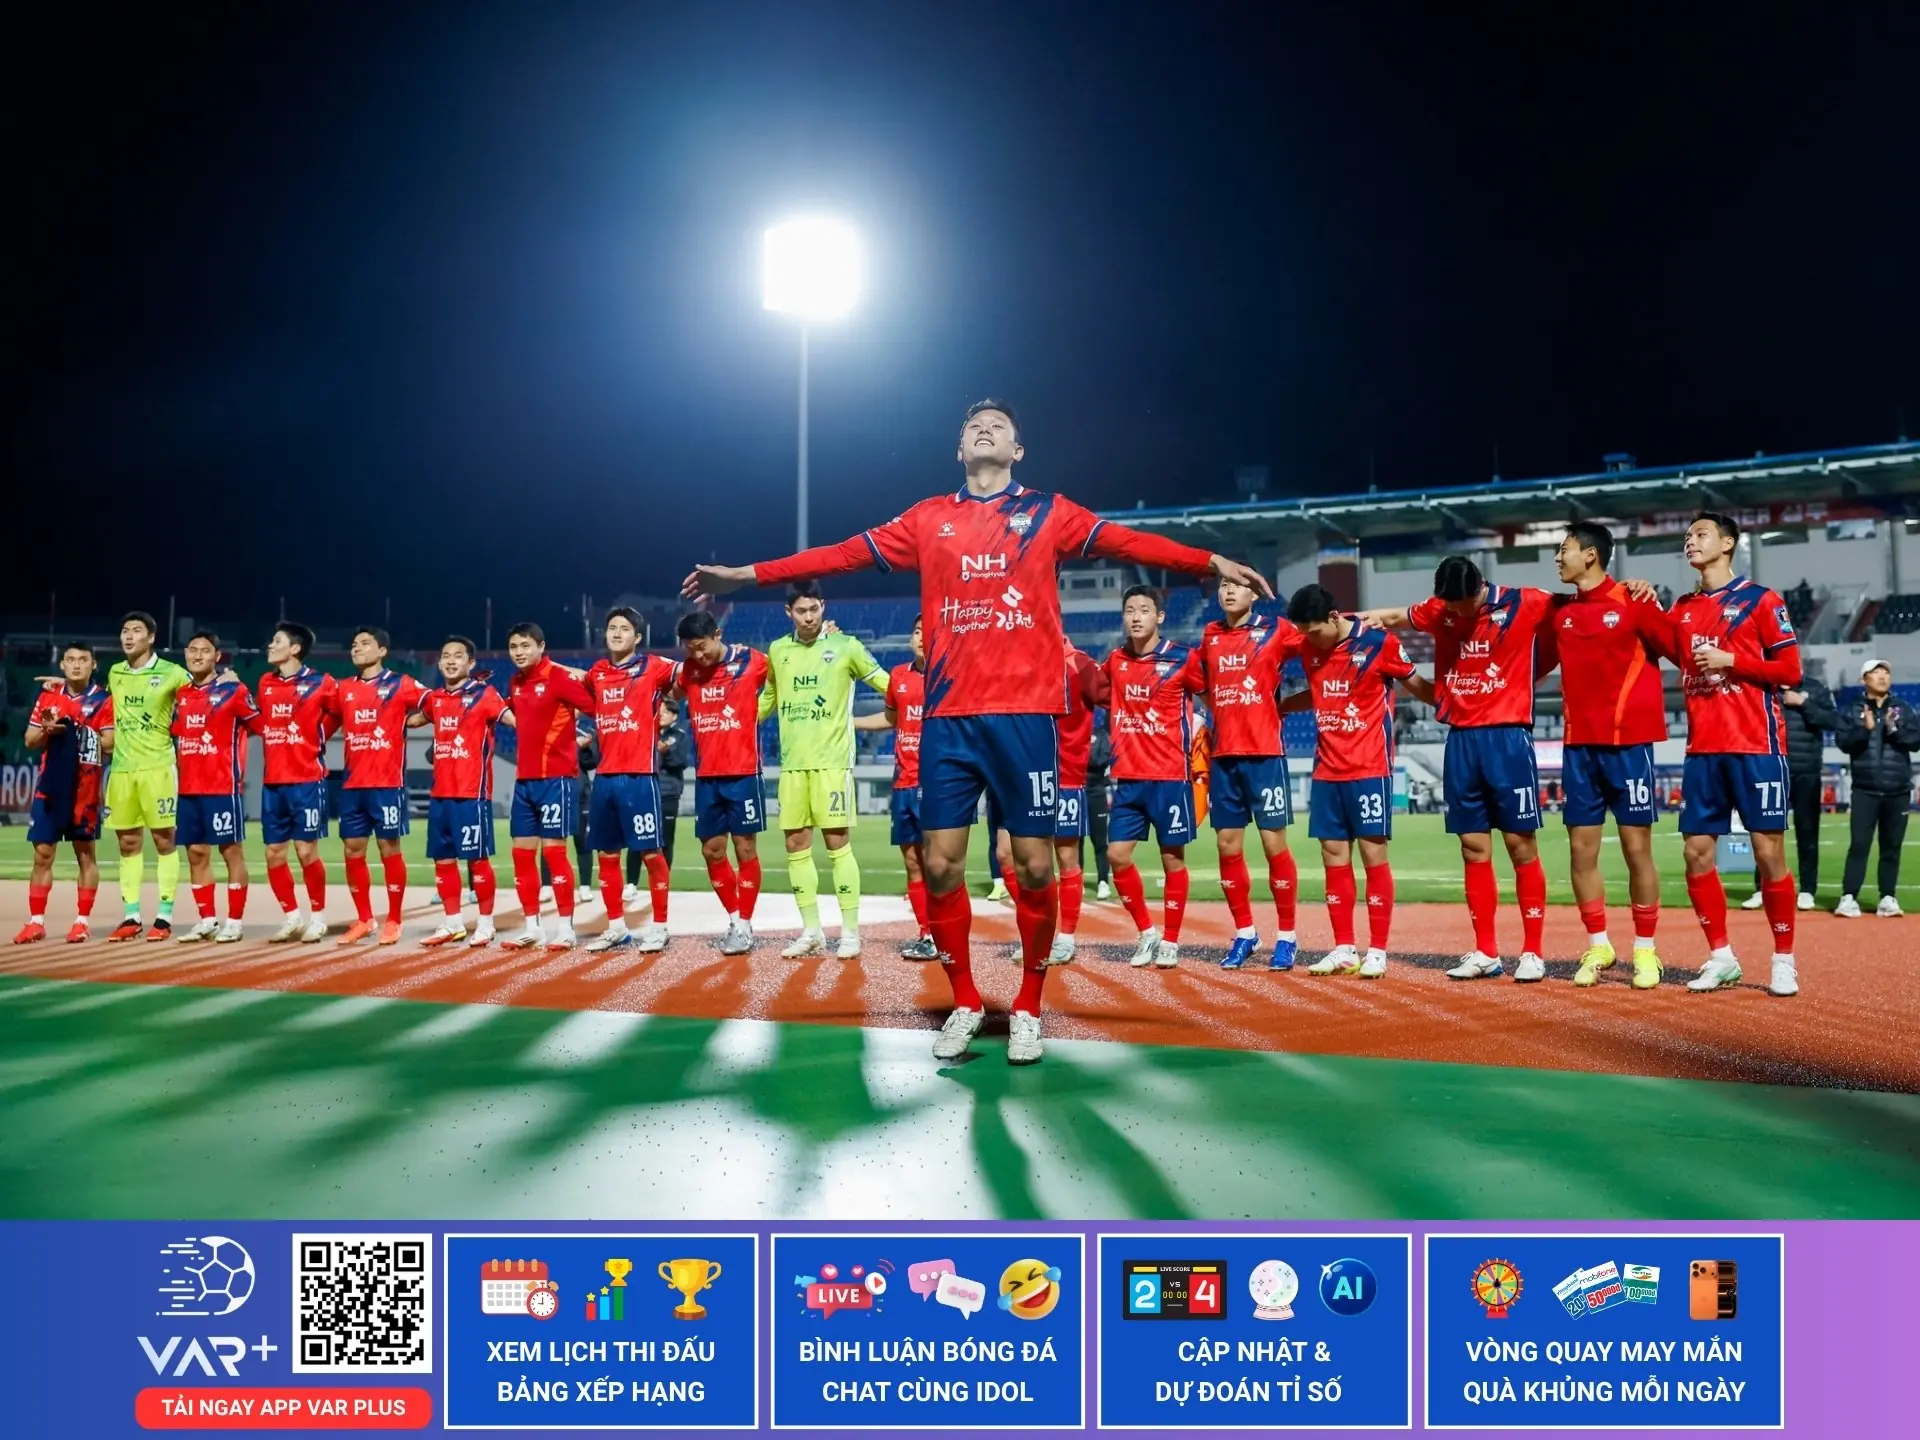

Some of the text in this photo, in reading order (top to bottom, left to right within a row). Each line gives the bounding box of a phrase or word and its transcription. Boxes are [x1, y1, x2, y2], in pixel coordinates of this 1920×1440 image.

[961, 553, 1006, 571] NH
[940, 596, 993, 625] Happy
[952, 621, 992, 634] together
[1460, 640, 1490, 653] NH
[1219, 654, 1247, 666] NH
[793, 675, 818, 686] NH
[1125, 684, 1150, 696] NH
[1323, 680, 1349, 692] NH
[124, 695, 145, 704] NH
[602, 687, 625, 698] NH
[701, 686, 725, 698] NH
[271, 703, 293, 714] NH
[354, 708, 377, 719] NH
[186, 714, 206, 724] NH
[440, 716, 459, 727] NH
[1028, 770, 1055, 807] 15
[1261, 786, 1285, 811] 28
[1625, 778, 1649, 805] 16
[1754, 781, 1782, 809] 77
[157, 797, 176, 815] 32
[829, 791, 847, 811] 21
[1358, 793, 1383, 818] 33
[1513, 786, 1535, 813] 71
[304, 808, 319, 828] 10
[382, 805, 399, 826] 18
[541, 803, 561, 824] 22
[744, 800, 757, 820] 5
[1028, 809, 1055, 817] KELME
[1057, 798, 1079, 822] 29
[1168, 804, 1183, 829] 2
[212, 811, 233, 832] 62
[632, 812, 656, 834] 88
[461, 825, 480, 846] 27
